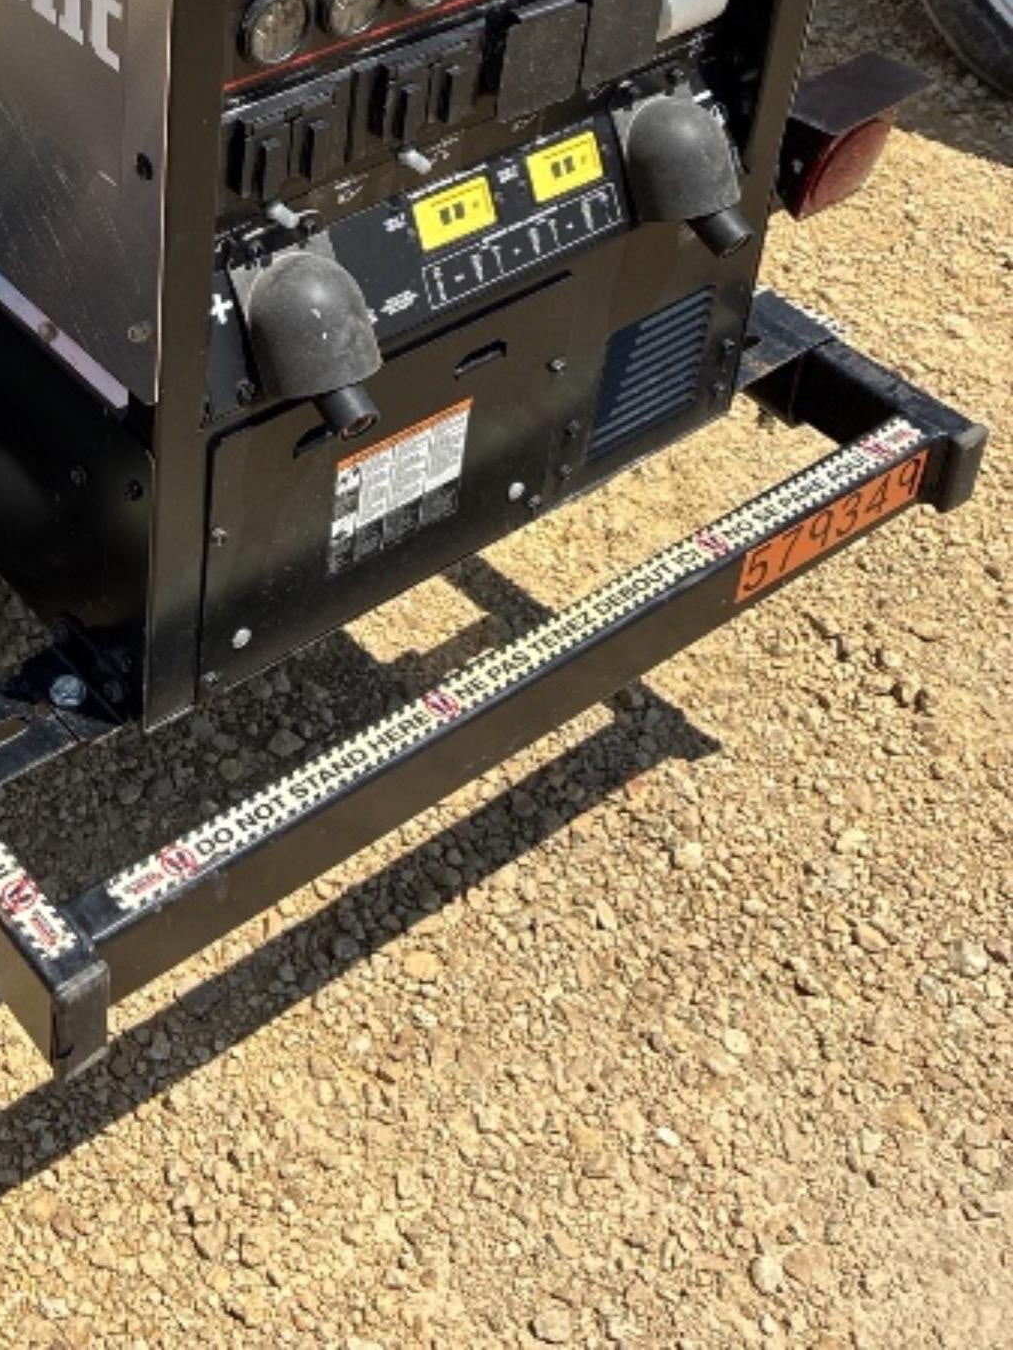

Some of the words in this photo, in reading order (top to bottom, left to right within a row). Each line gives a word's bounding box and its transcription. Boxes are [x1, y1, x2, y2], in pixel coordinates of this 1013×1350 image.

[743, 457, 921, 593] 579349
[453, 676, 485, 701] NE
[487, 650, 532, 681] PAS
[528, 612, 597, 649] TENEZ
[592, 563, 673, 614] DEBOUT
[672, 548, 703, 566] ICI
[195, 826, 234, 856] DO
[237, 794, 288, 831] NOT
[289, 749, 369, 799] STAND
[368, 711, 431, 751] HERE
